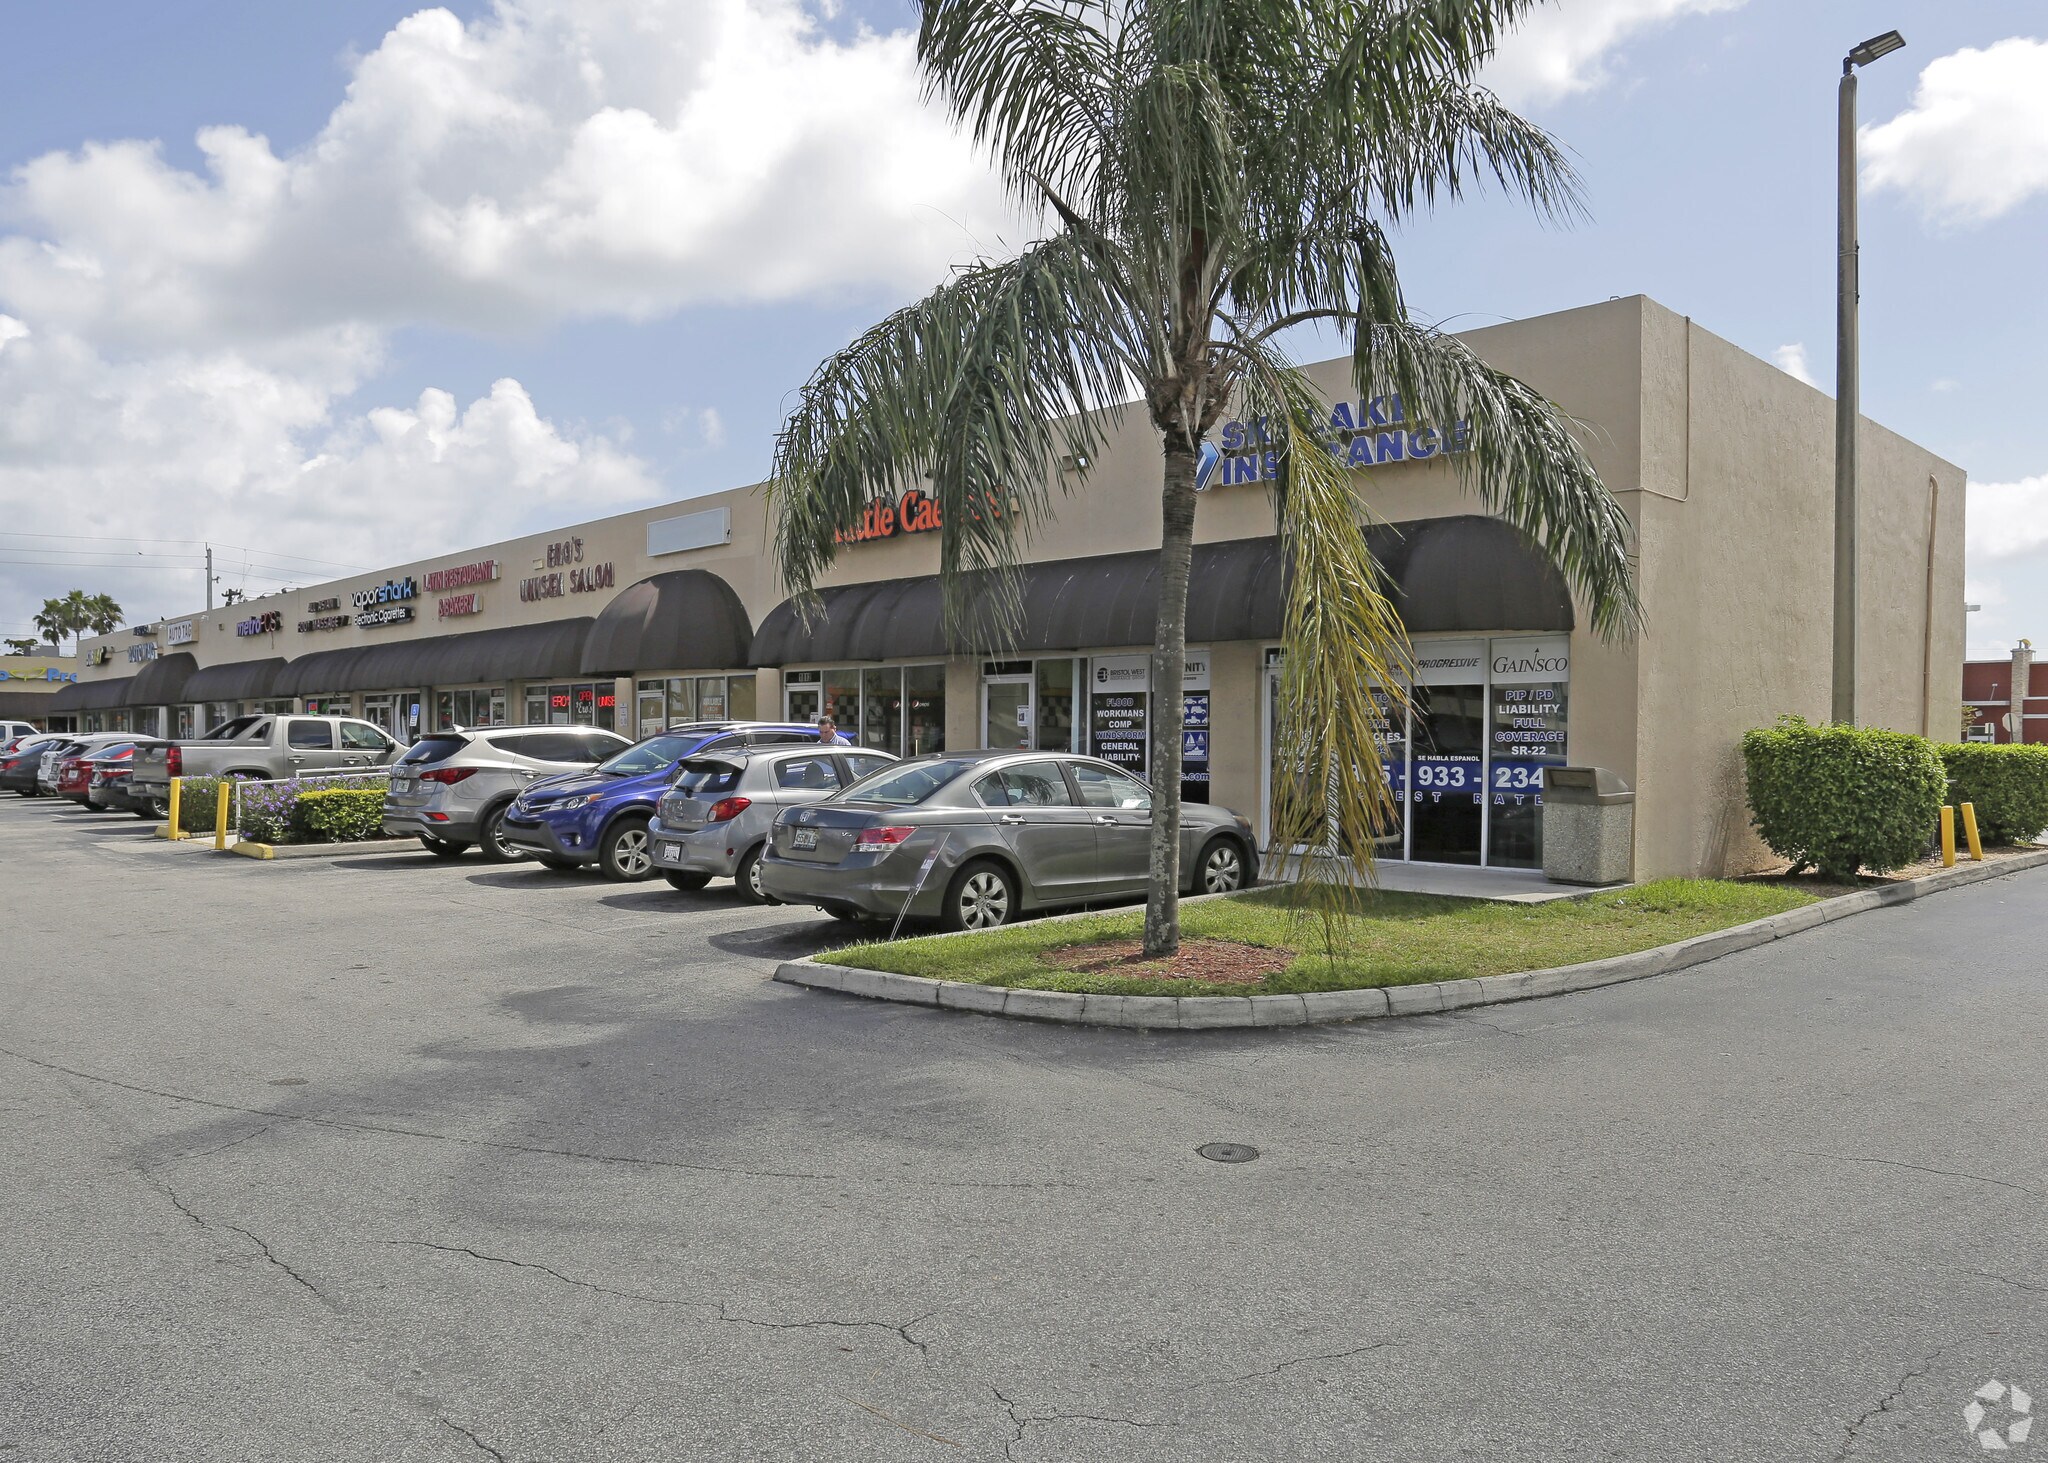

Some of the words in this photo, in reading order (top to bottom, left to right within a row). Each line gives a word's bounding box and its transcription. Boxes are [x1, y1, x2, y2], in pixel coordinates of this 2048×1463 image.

[423, 571, 442, 592] LATIN
[445, 560, 494, 587] RESTAURANT
[520, 573, 564, 602] UNISEX
[570, 562, 615, 594] SALON
[354, 611, 378, 626] Electronic
[378, 607, 406, 624] Cigarettes
[236, 611, 278, 638] metroPCS
[168, 627, 181, 641] AUTO
[182, 624, 192, 638] TAG
[1417, 657, 1481, 669] PROGRESSIVE
[1493, 653, 1568, 674] GAINSCO
[1505, 691, 1527, 700] PIP
[1536, 690, 1554, 700] PD
[1106, 698, 1134, 707] FLOOD
[1096, 709, 1144, 718] WORKMANS
[1498, 704, 1560, 714] LIABILITY
[1108, 720, 1132, 728] COMP
[1513, 718, 1546, 728] FULL
[1095, 730, 1146, 740] WINDSTORM
[1495, 732, 1565, 743] COVERAGE
[1101, 742, 1139, 751] GENERAL
[1511, 746, 1547, 755] SR-22
[1100, 753, 1140, 762] LIABILITY
[1418, 766, 1466, 787] 933
[1495, 767, 1544, 788] 234
